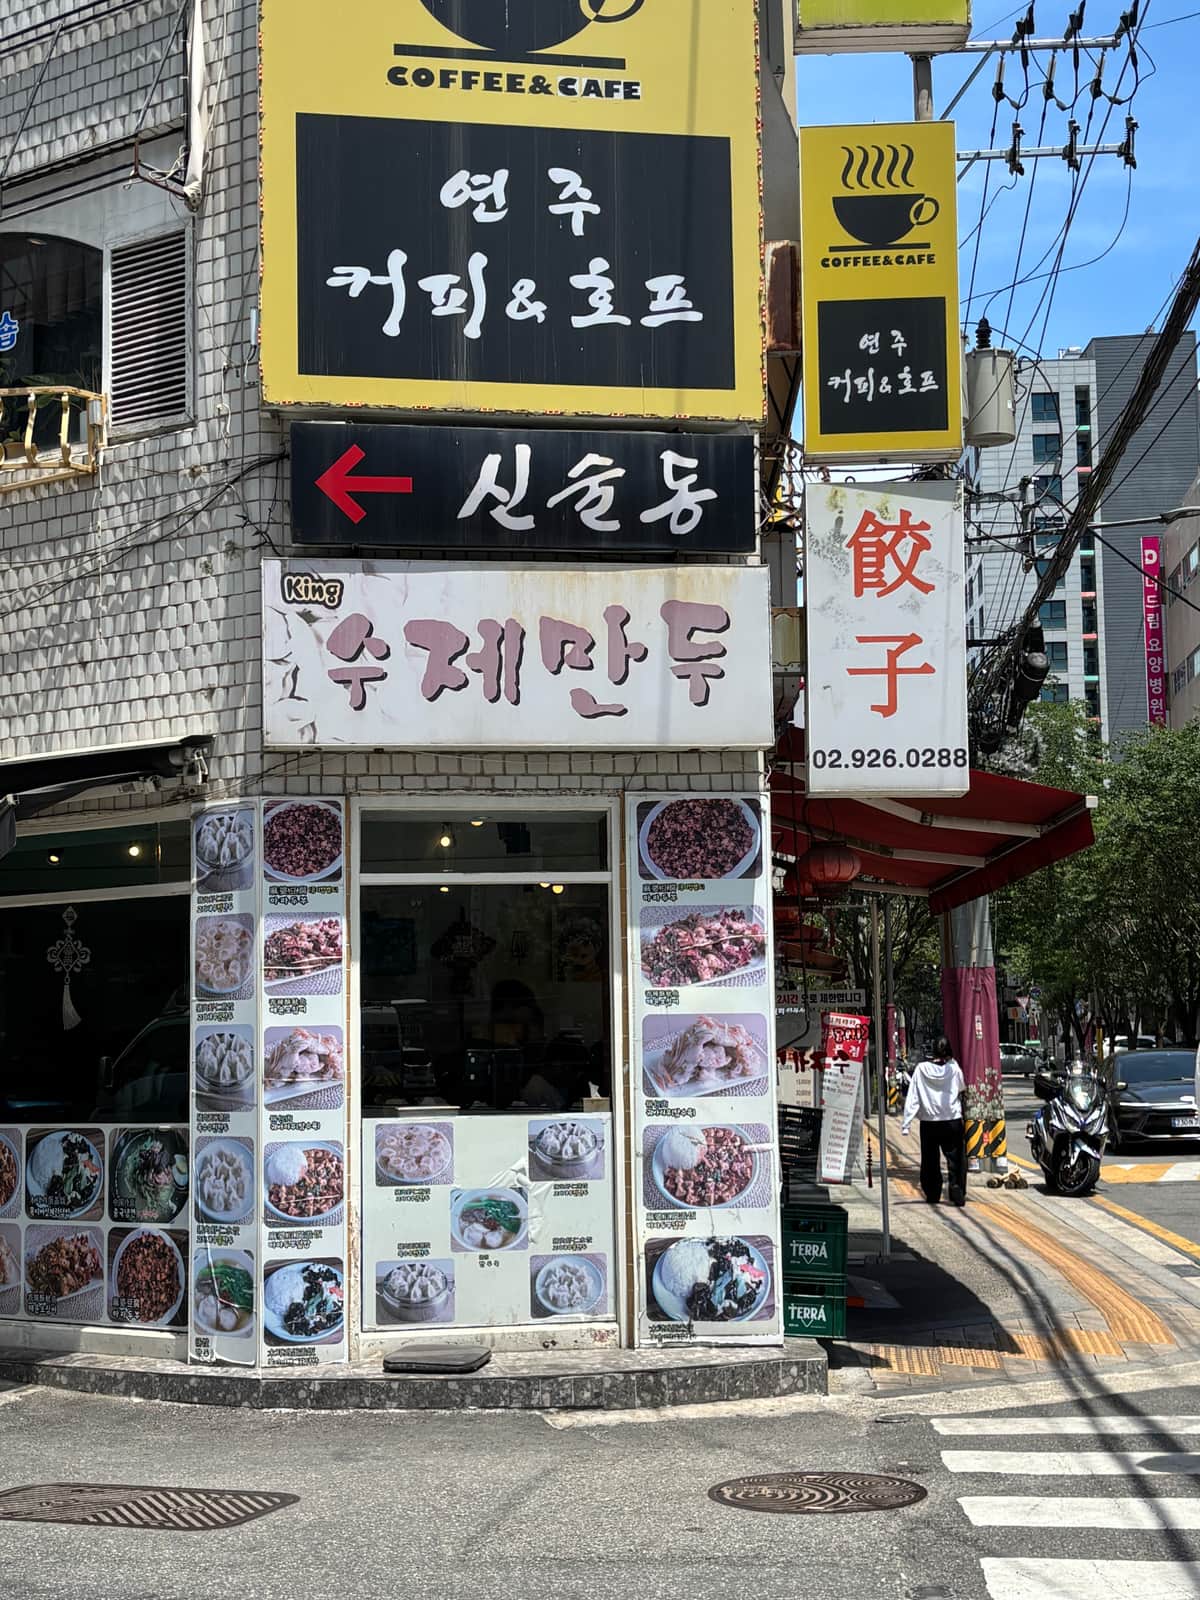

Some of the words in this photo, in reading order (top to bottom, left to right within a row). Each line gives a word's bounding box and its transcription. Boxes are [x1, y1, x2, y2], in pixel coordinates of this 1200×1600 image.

[386, 65, 641, 100] COFFEE&CAFE
[820, 253, 936, 268] COFFEE&CAFE
[326, 248, 704, 339] 커피&호프
[828, 366, 939, 403] 커피&호프
[281, 572, 344, 609] King
[846, 508, 936, 719] 餃子
[326, 600, 732, 719] 수제만두
[1148, 639, 1164, 715] 요양병원
[813, 747, 968, 769] 02.926.0288
[777, 993, 799, 1004] 2시간
